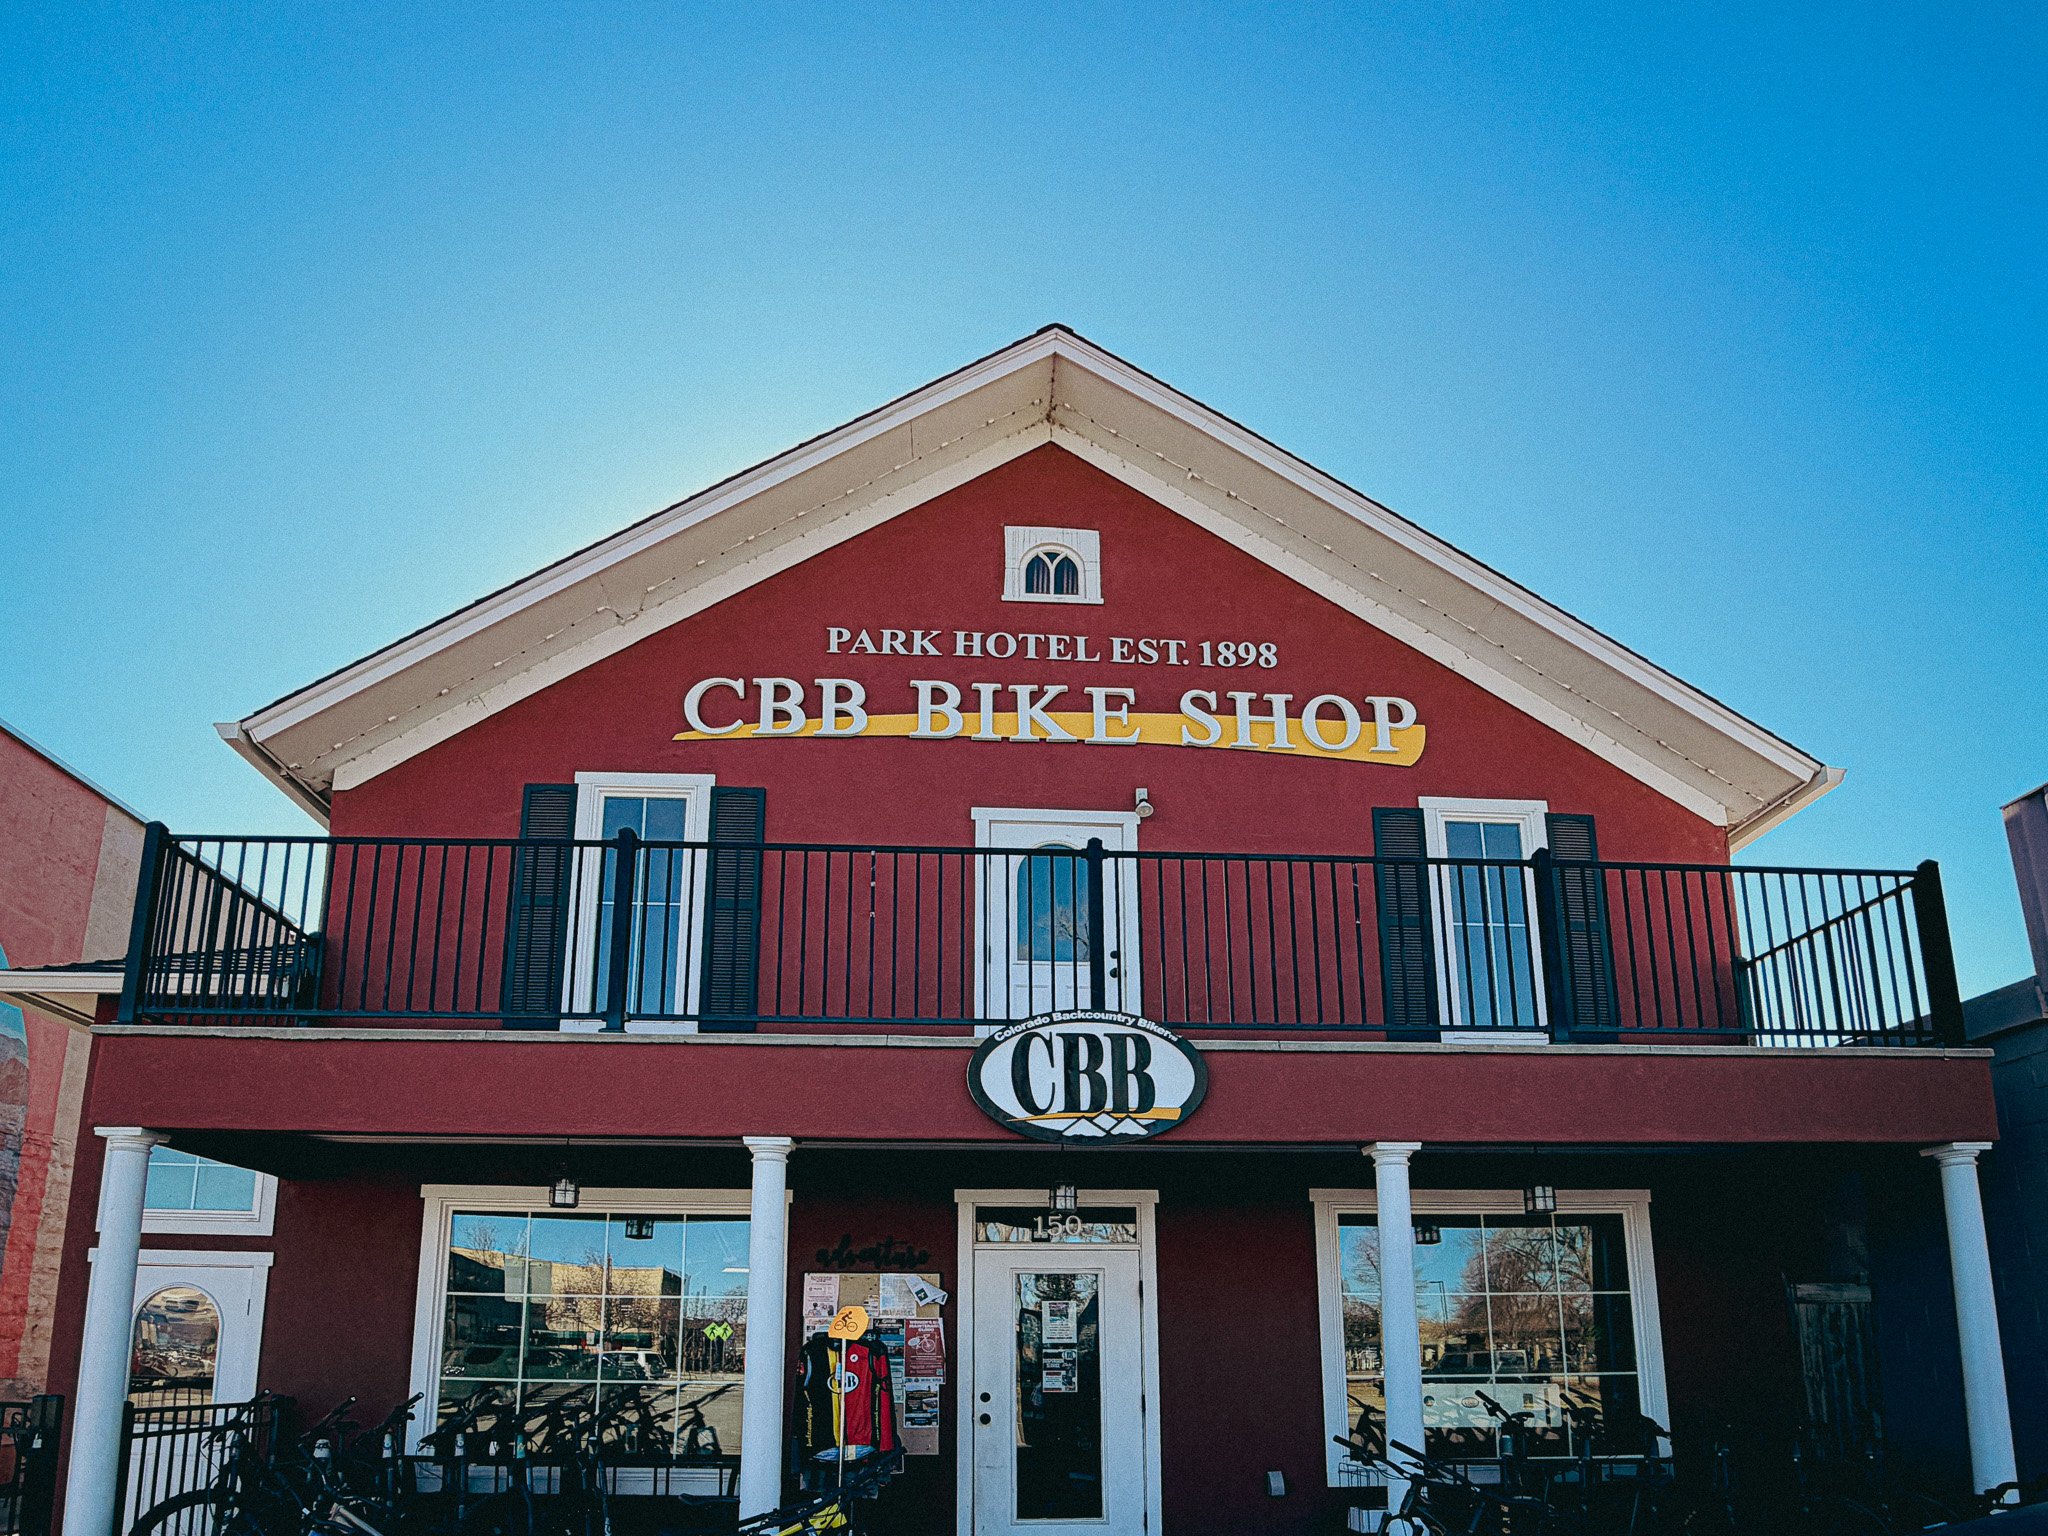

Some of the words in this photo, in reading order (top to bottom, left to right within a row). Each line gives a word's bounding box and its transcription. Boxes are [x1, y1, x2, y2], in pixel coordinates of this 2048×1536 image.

[826, 627, 943, 656] PARK
[952, 631, 1100, 662] HOTEL
[1109, 636, 1190, 666] EST.
[1198, 640, 1279, 669] 1898
[684, 677, 869, 737] CBB
[909, 679, 1142, 744] BIKE
[1179, 689, 1418, 753] SHOP
[993, 1016, 1050, 1042] Colorado
[1052, 1010, 1136, 1026] Backcountry
[1011, 1031, 1156, 1115] CBB
[1033, 1213, 1082, 1236] 150
